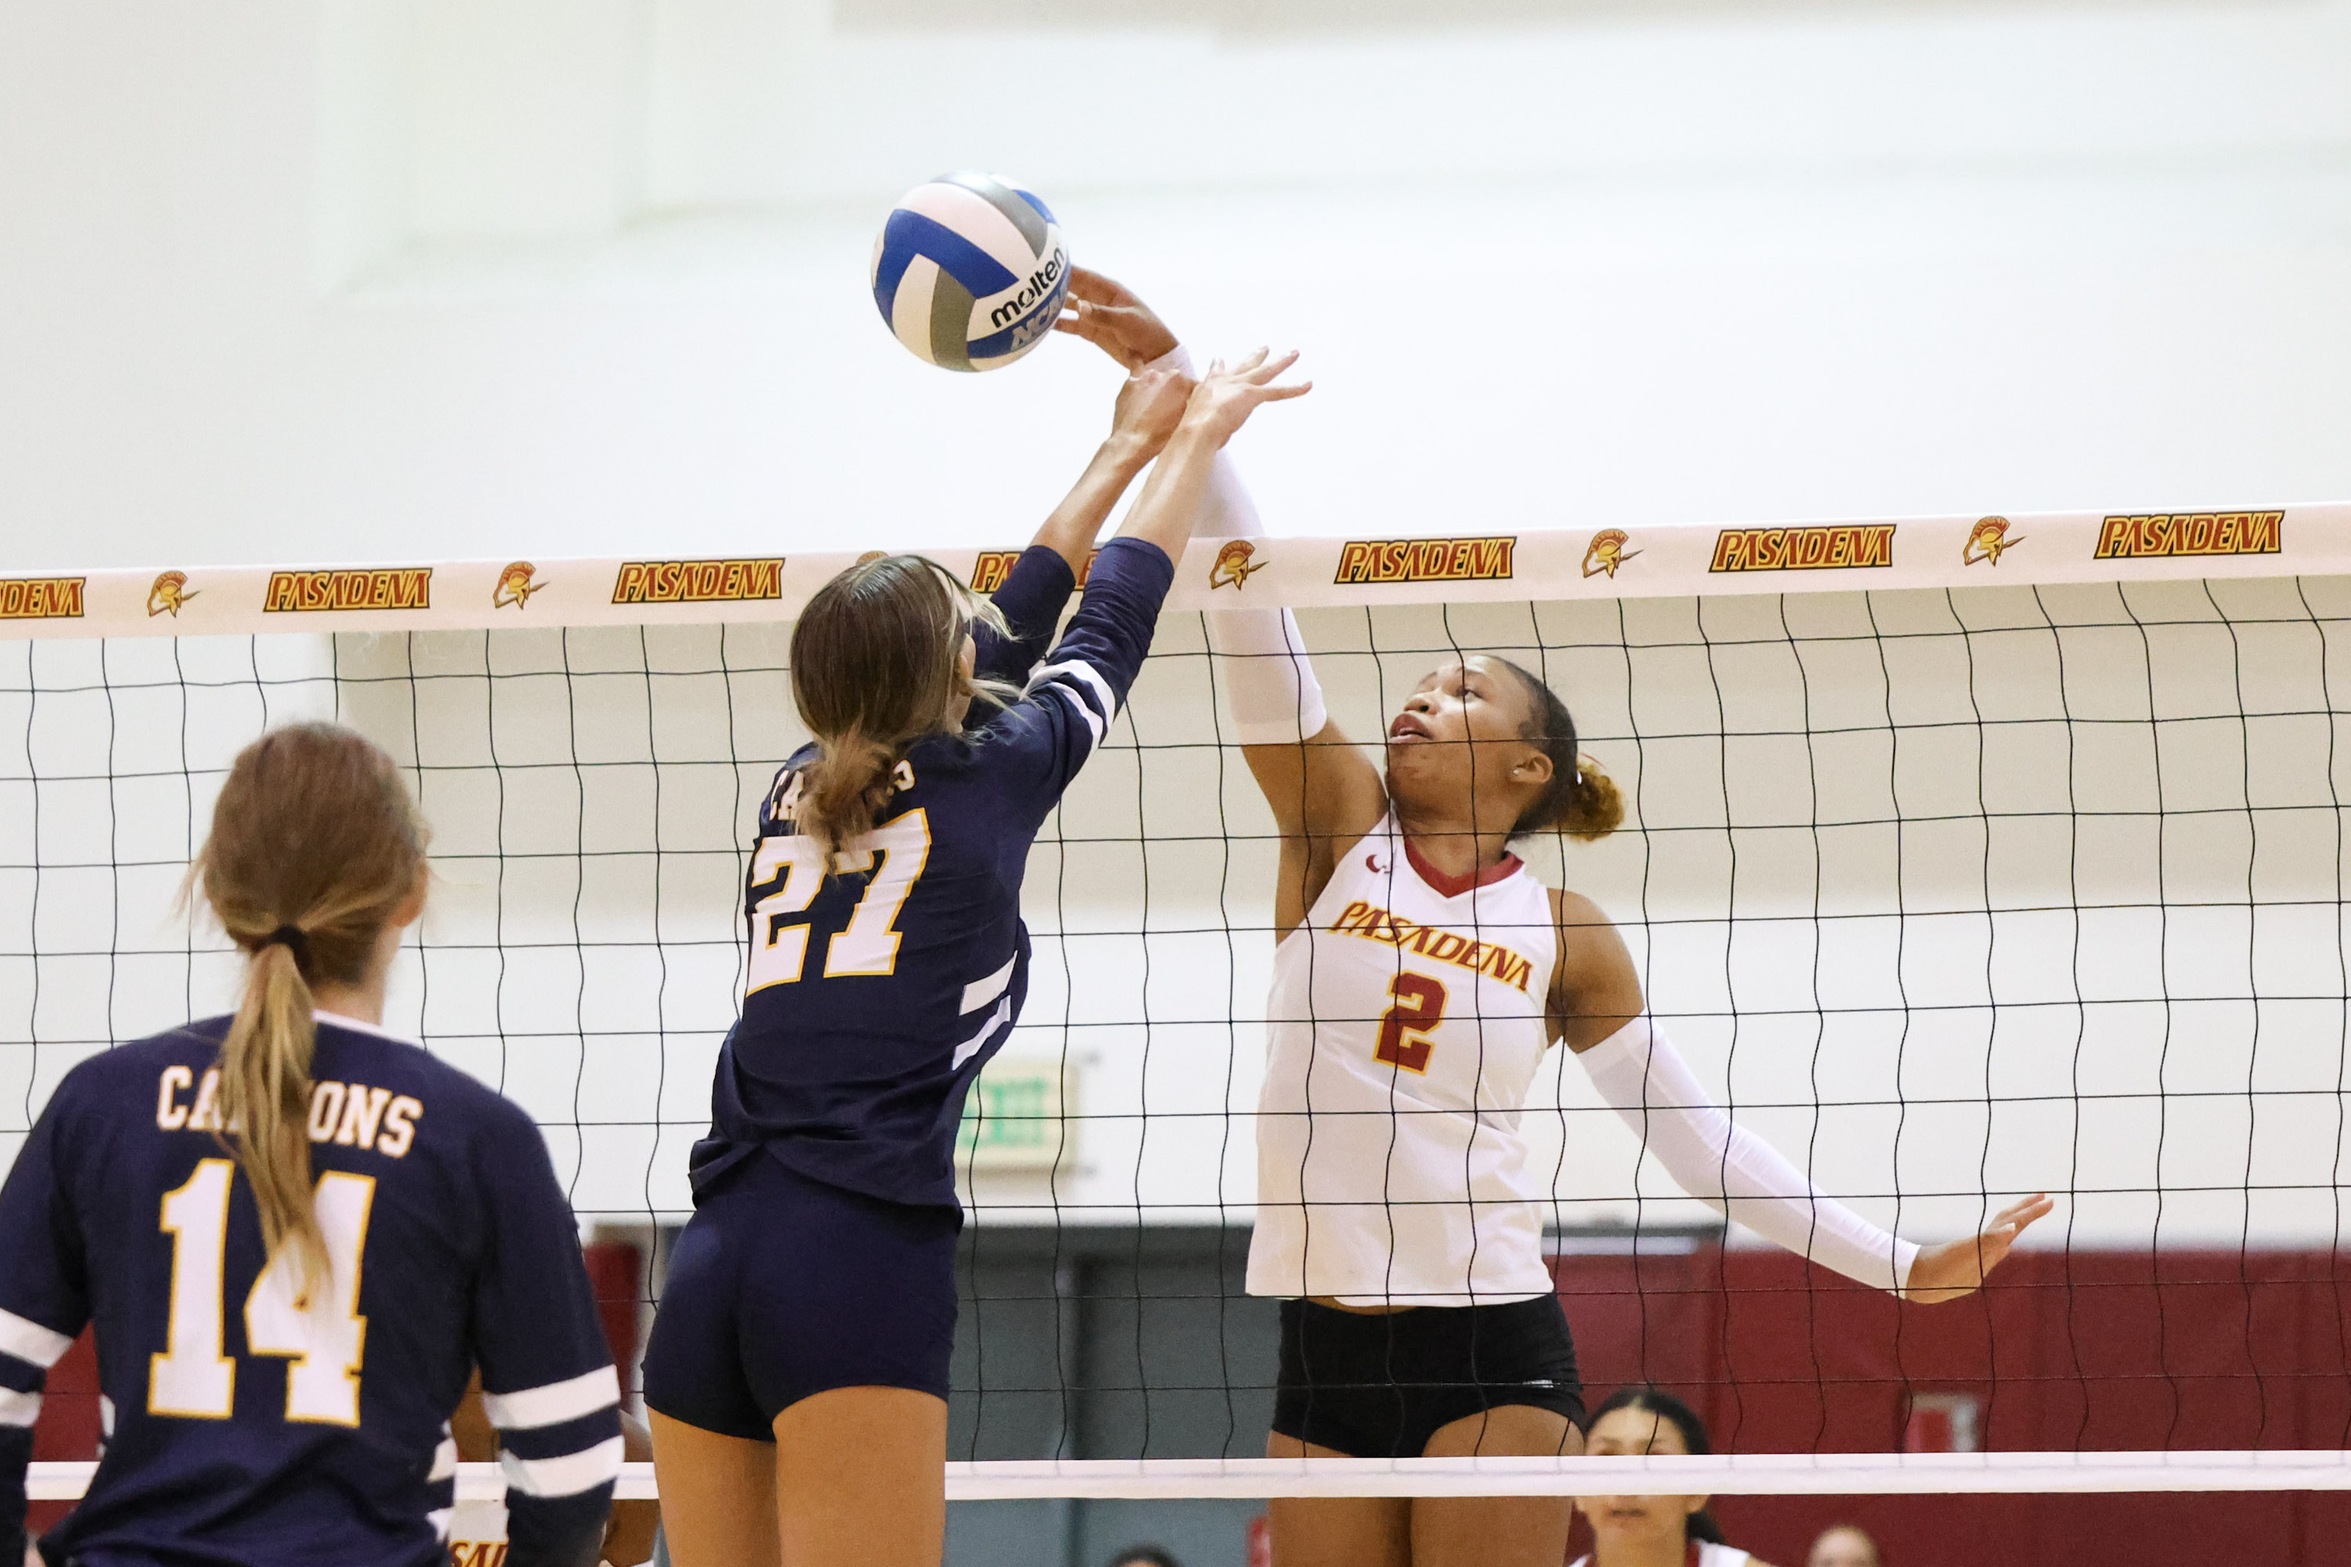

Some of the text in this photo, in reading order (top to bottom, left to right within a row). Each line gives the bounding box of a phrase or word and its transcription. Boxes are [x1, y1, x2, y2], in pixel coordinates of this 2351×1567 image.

[991, 247, 1065, 328] molten
[0, 510, 2285, 619] DENA PASADENA PASADENA PASADENA PASADENA PASADENA
[746, 807, 932, 998] 27
[1328, 901, 1534, 992] PASADENA
[1373, 971, 1449, 1077] 2
[156, 1065, 424, 1159] CAONS
[147, 1158, 376, 1429] 14
